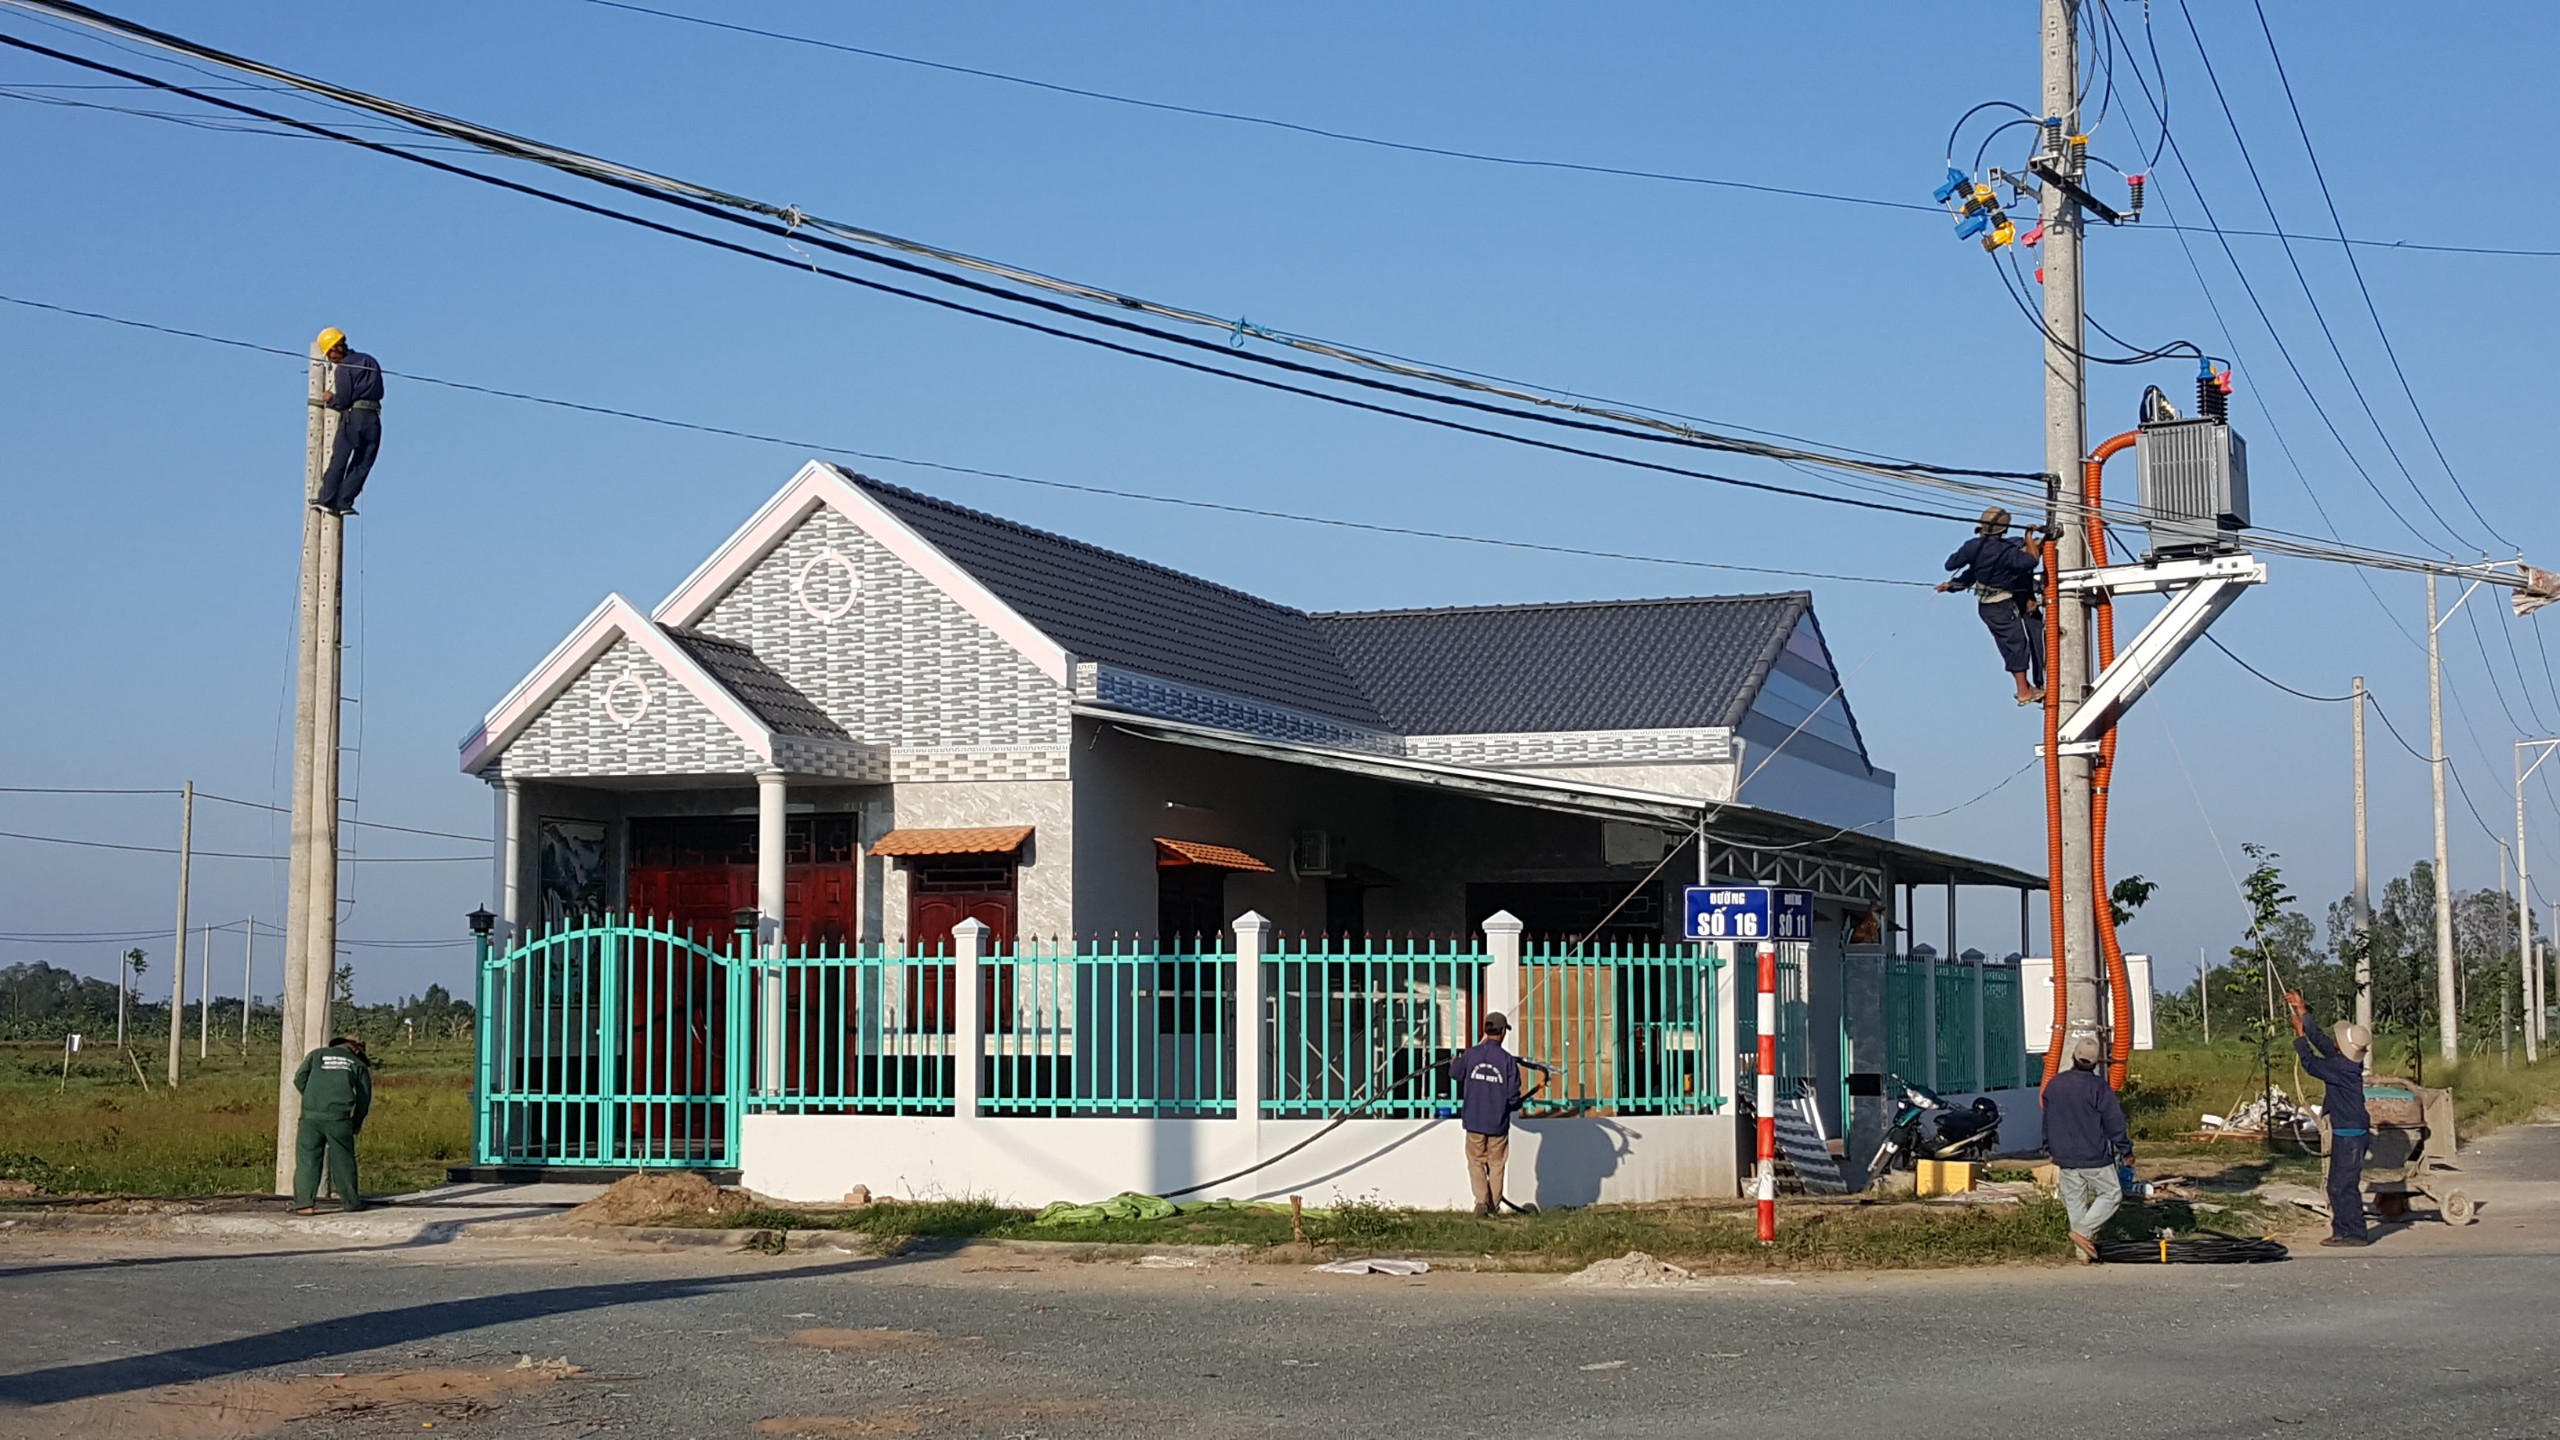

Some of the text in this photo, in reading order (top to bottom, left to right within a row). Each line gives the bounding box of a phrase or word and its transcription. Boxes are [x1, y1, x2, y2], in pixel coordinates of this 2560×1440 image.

[1709, 891, 1746, 905] ĐƯỜNG
[1697, 906, 1758, 936] SỐ 16
[1779, 907, 1806, 937] SỐ 11
